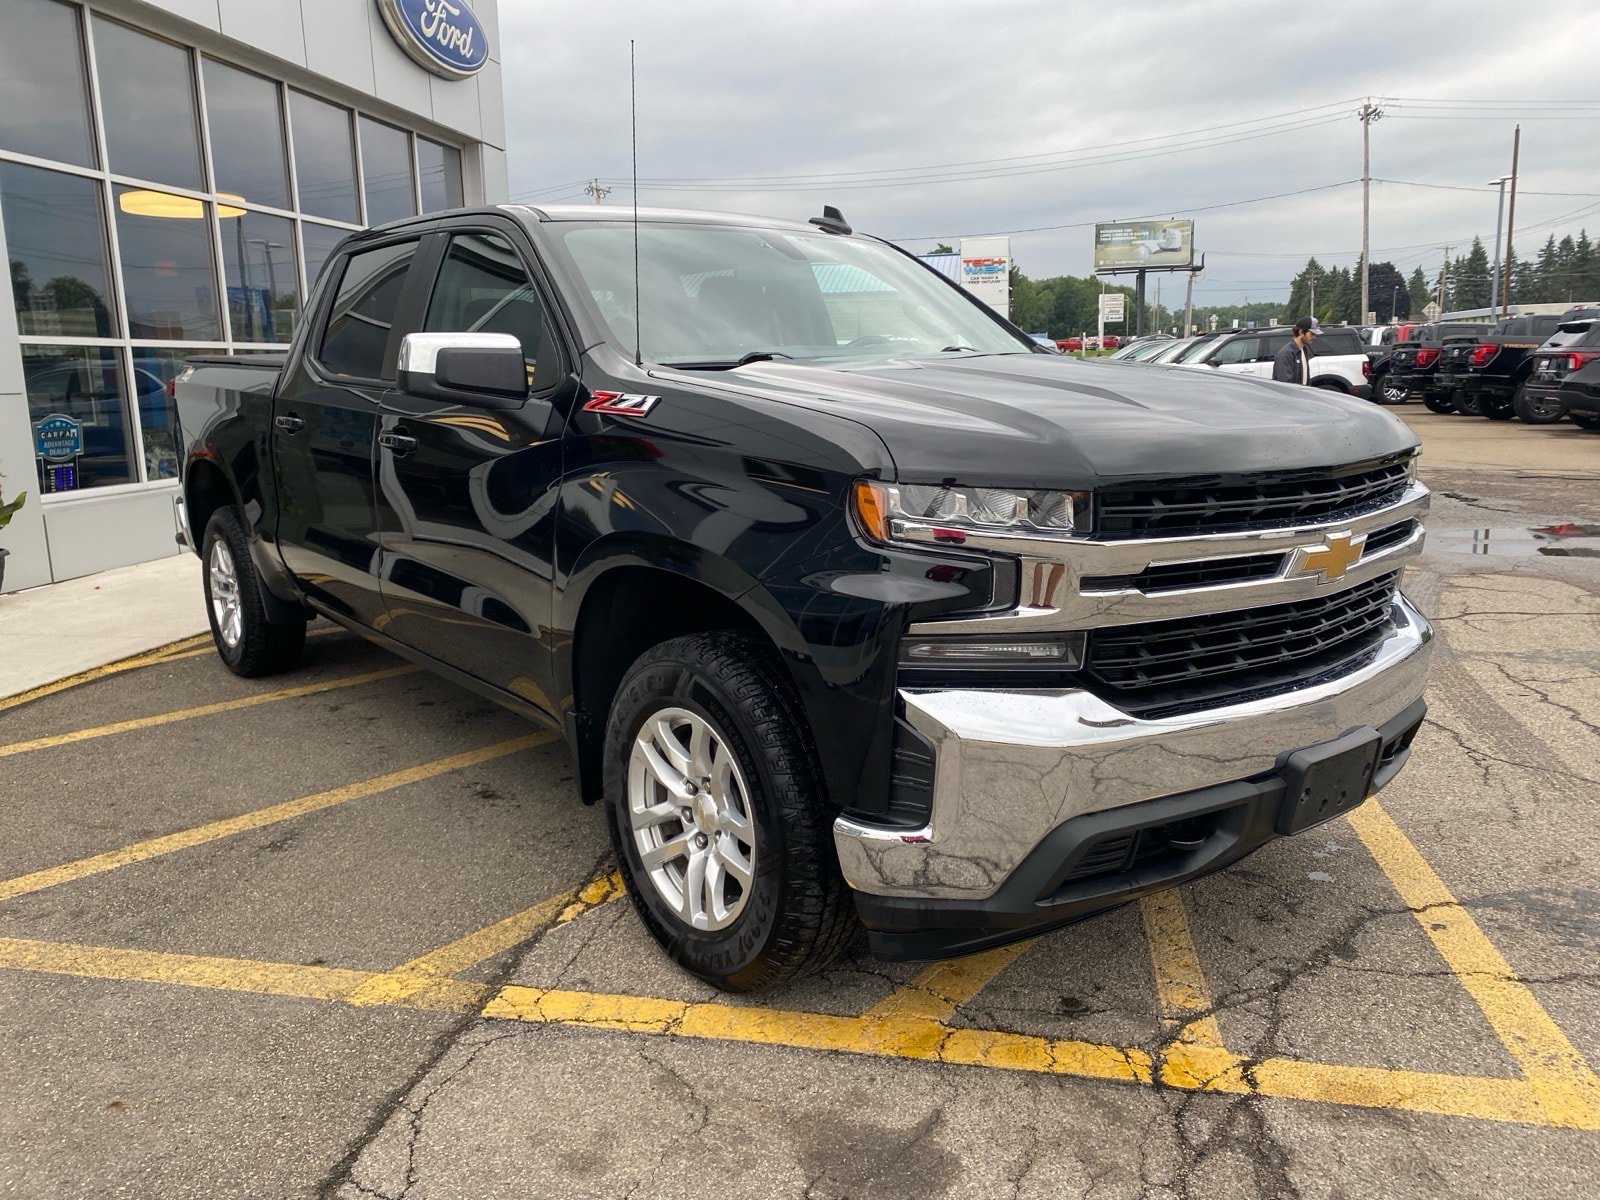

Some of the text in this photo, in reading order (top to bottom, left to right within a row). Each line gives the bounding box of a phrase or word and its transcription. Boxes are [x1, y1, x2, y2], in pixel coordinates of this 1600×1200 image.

[421, 0, 473, 58] Ford
[582, 390, 662, 417] Z71
[41, 428, 77, 439] CARFAX
[43, 439, 75, 448] ADVANTAGE
[49, 447, 71, 456] DEALER
